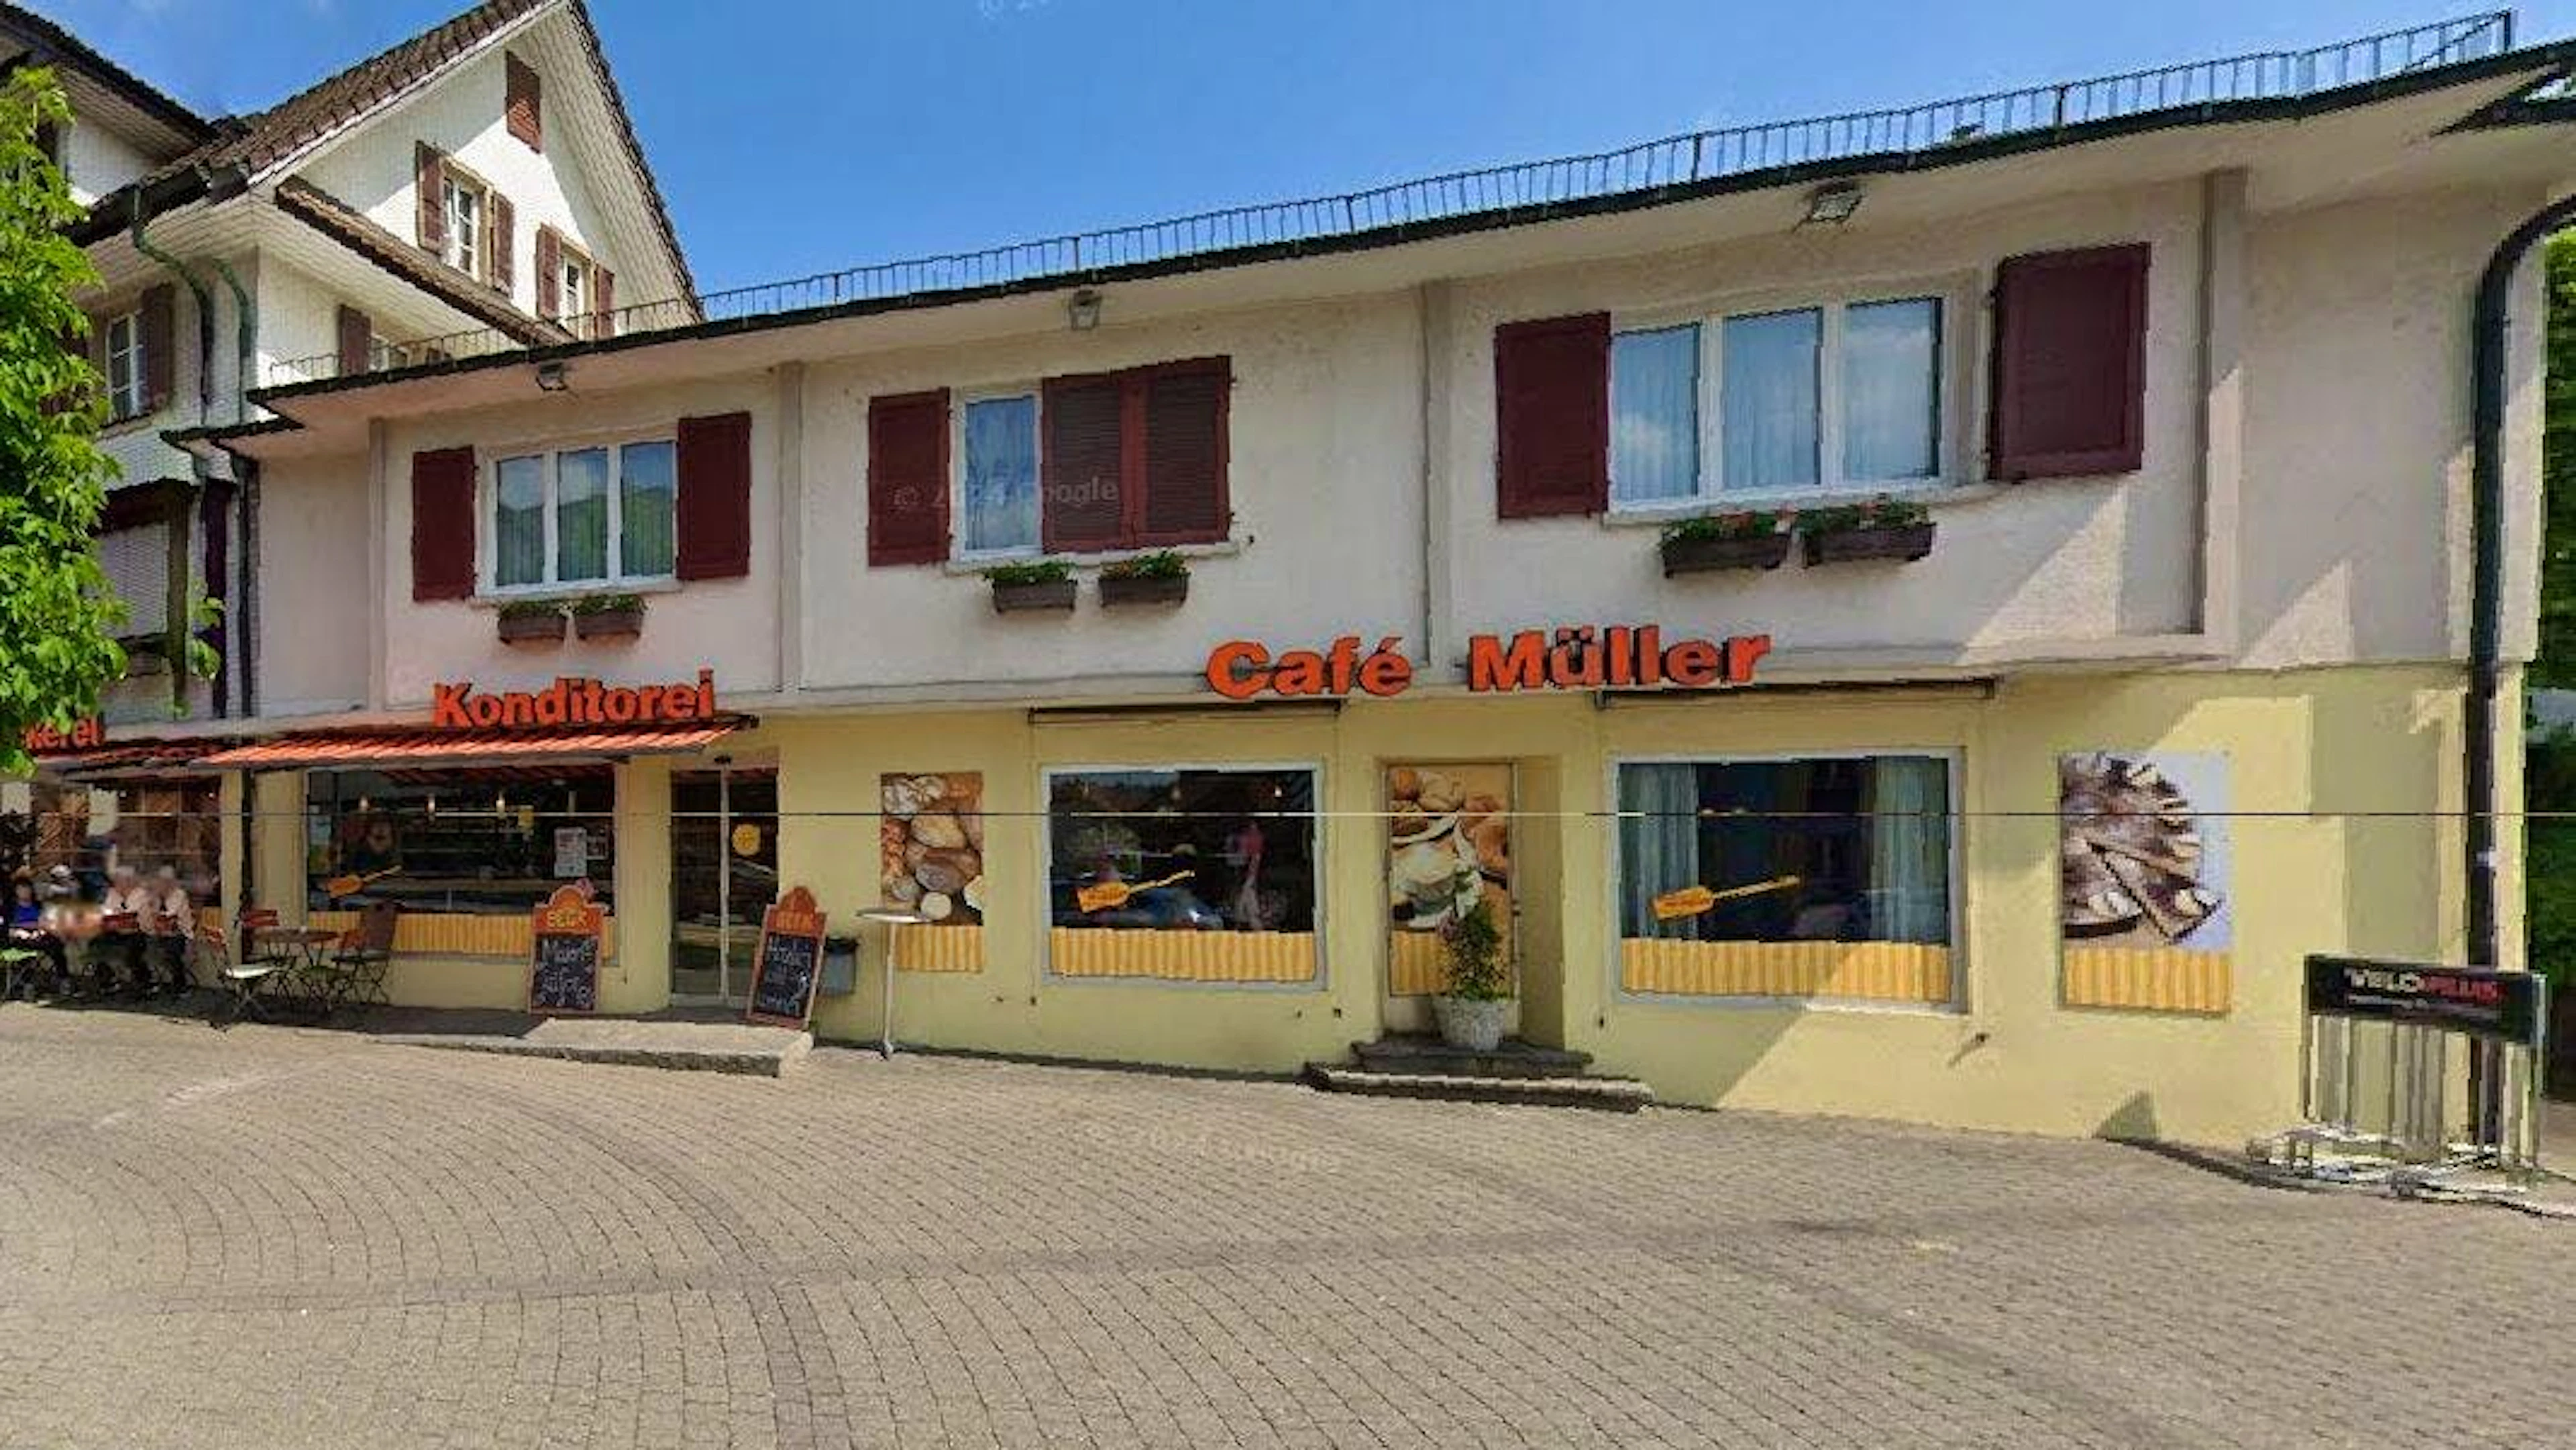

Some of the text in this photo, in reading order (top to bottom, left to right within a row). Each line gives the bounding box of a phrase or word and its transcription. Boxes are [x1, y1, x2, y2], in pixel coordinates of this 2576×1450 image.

[1206, 624, 1771, 698] Café Müller
[433, 669, 714, 727] Konditorei
